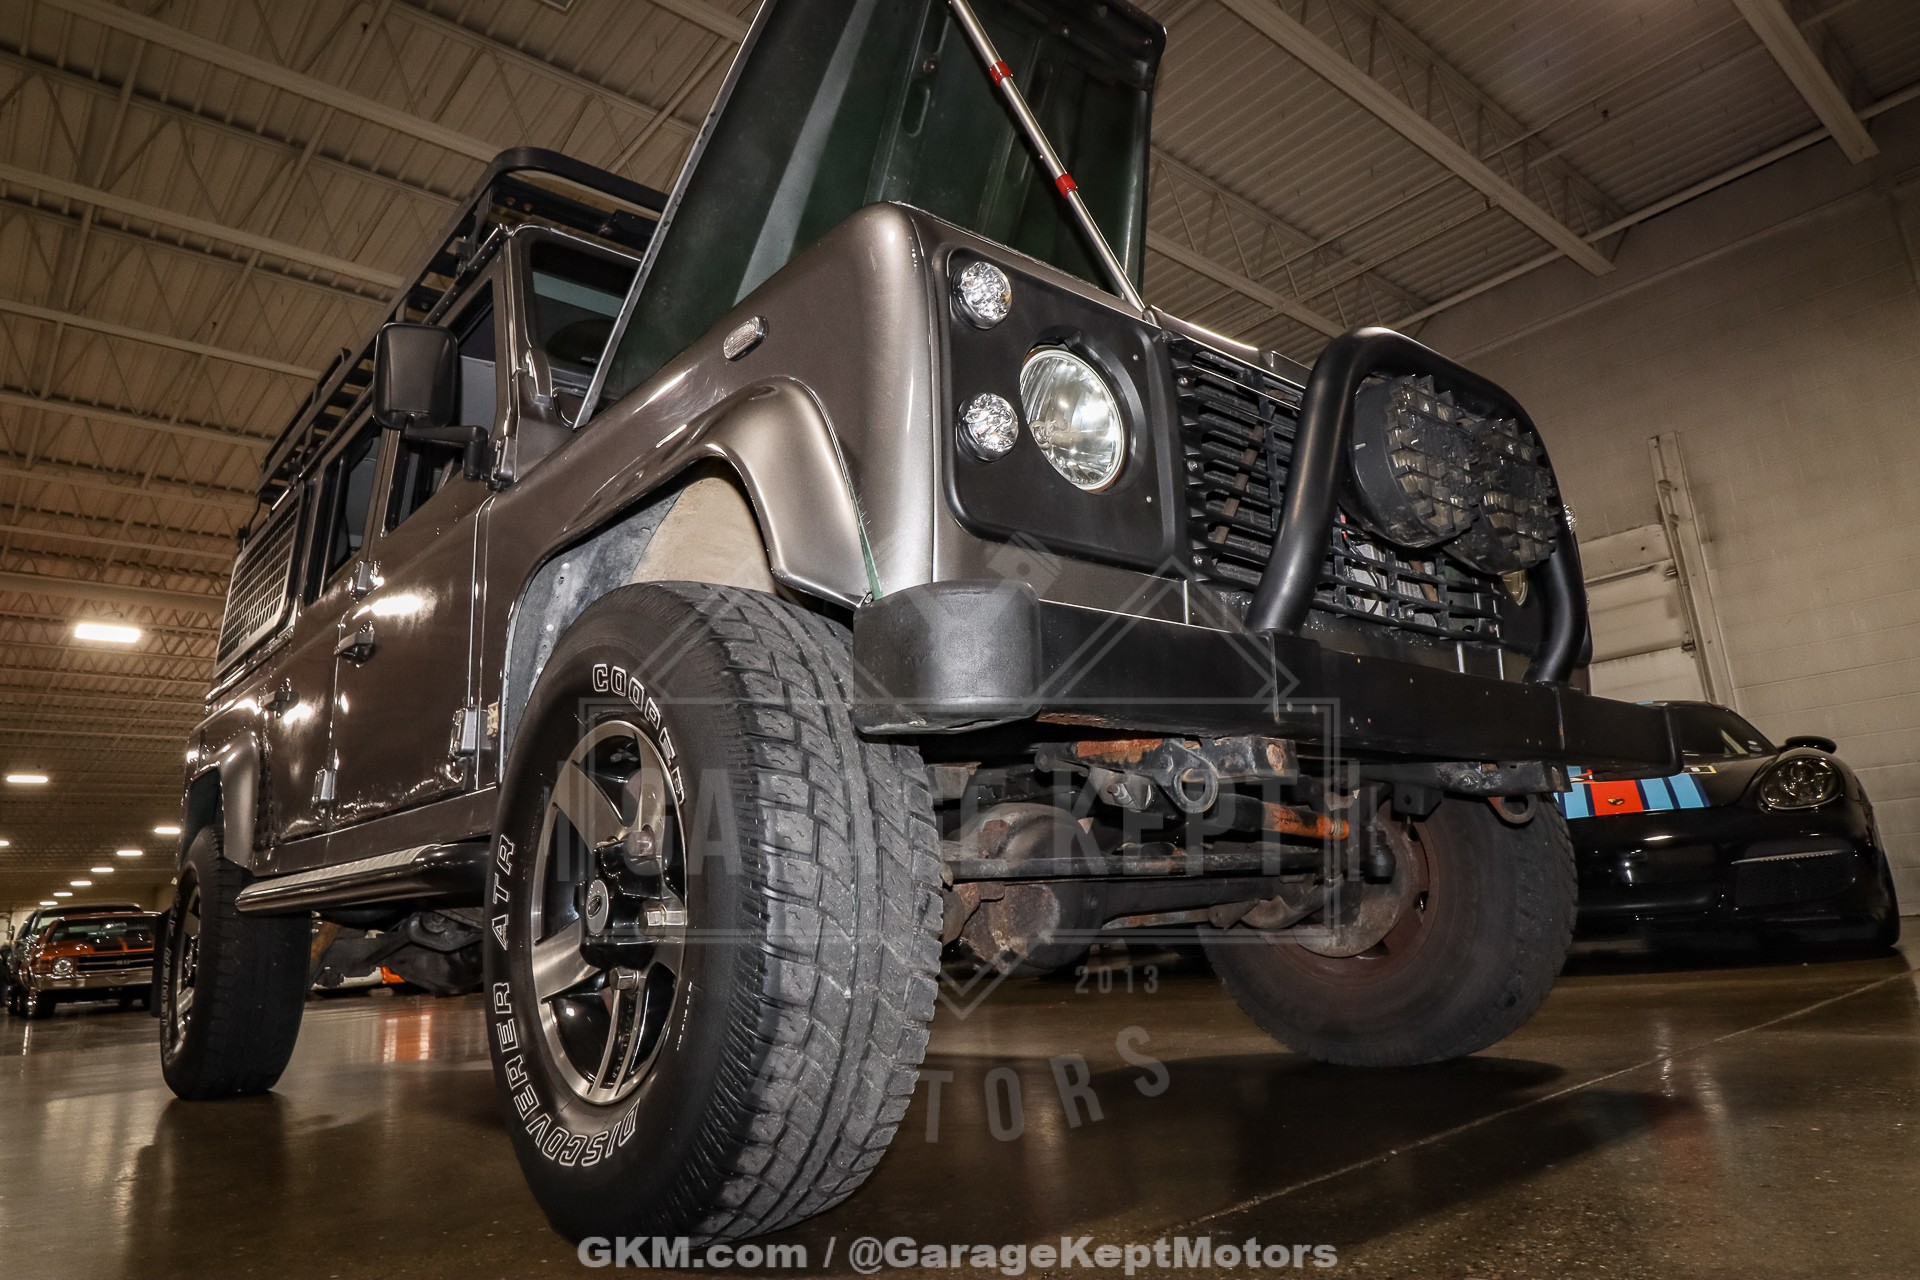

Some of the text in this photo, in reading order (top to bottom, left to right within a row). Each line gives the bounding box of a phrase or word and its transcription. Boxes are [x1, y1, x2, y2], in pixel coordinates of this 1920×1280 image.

[593, 663, 685, 805] COOPER
[491, 834, 641, 1167] DISCOVERER ATR
